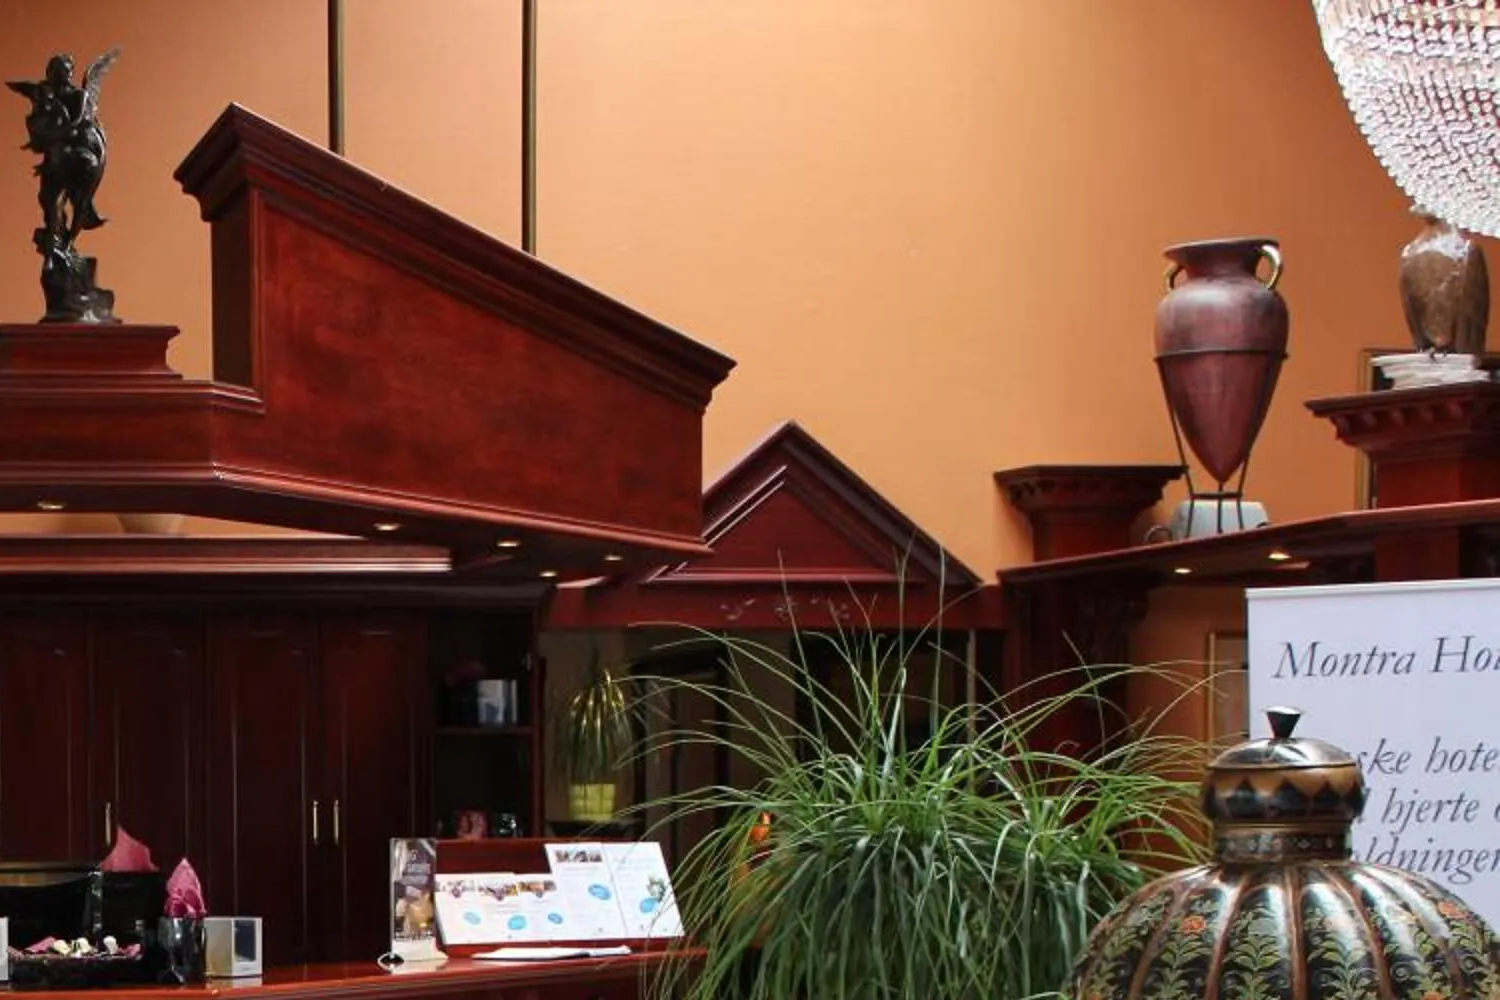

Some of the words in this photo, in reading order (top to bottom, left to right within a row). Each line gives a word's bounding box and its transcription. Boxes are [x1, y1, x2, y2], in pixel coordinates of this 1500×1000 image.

[1271, 640, 1416, 679] Montra
[1356, 737, 1412, 775] ske
[1424, 735, 1500, 774] hote
[1380, 786, 1481, 836] hjerte
[1355, 835, 1500, 886] ldninge
